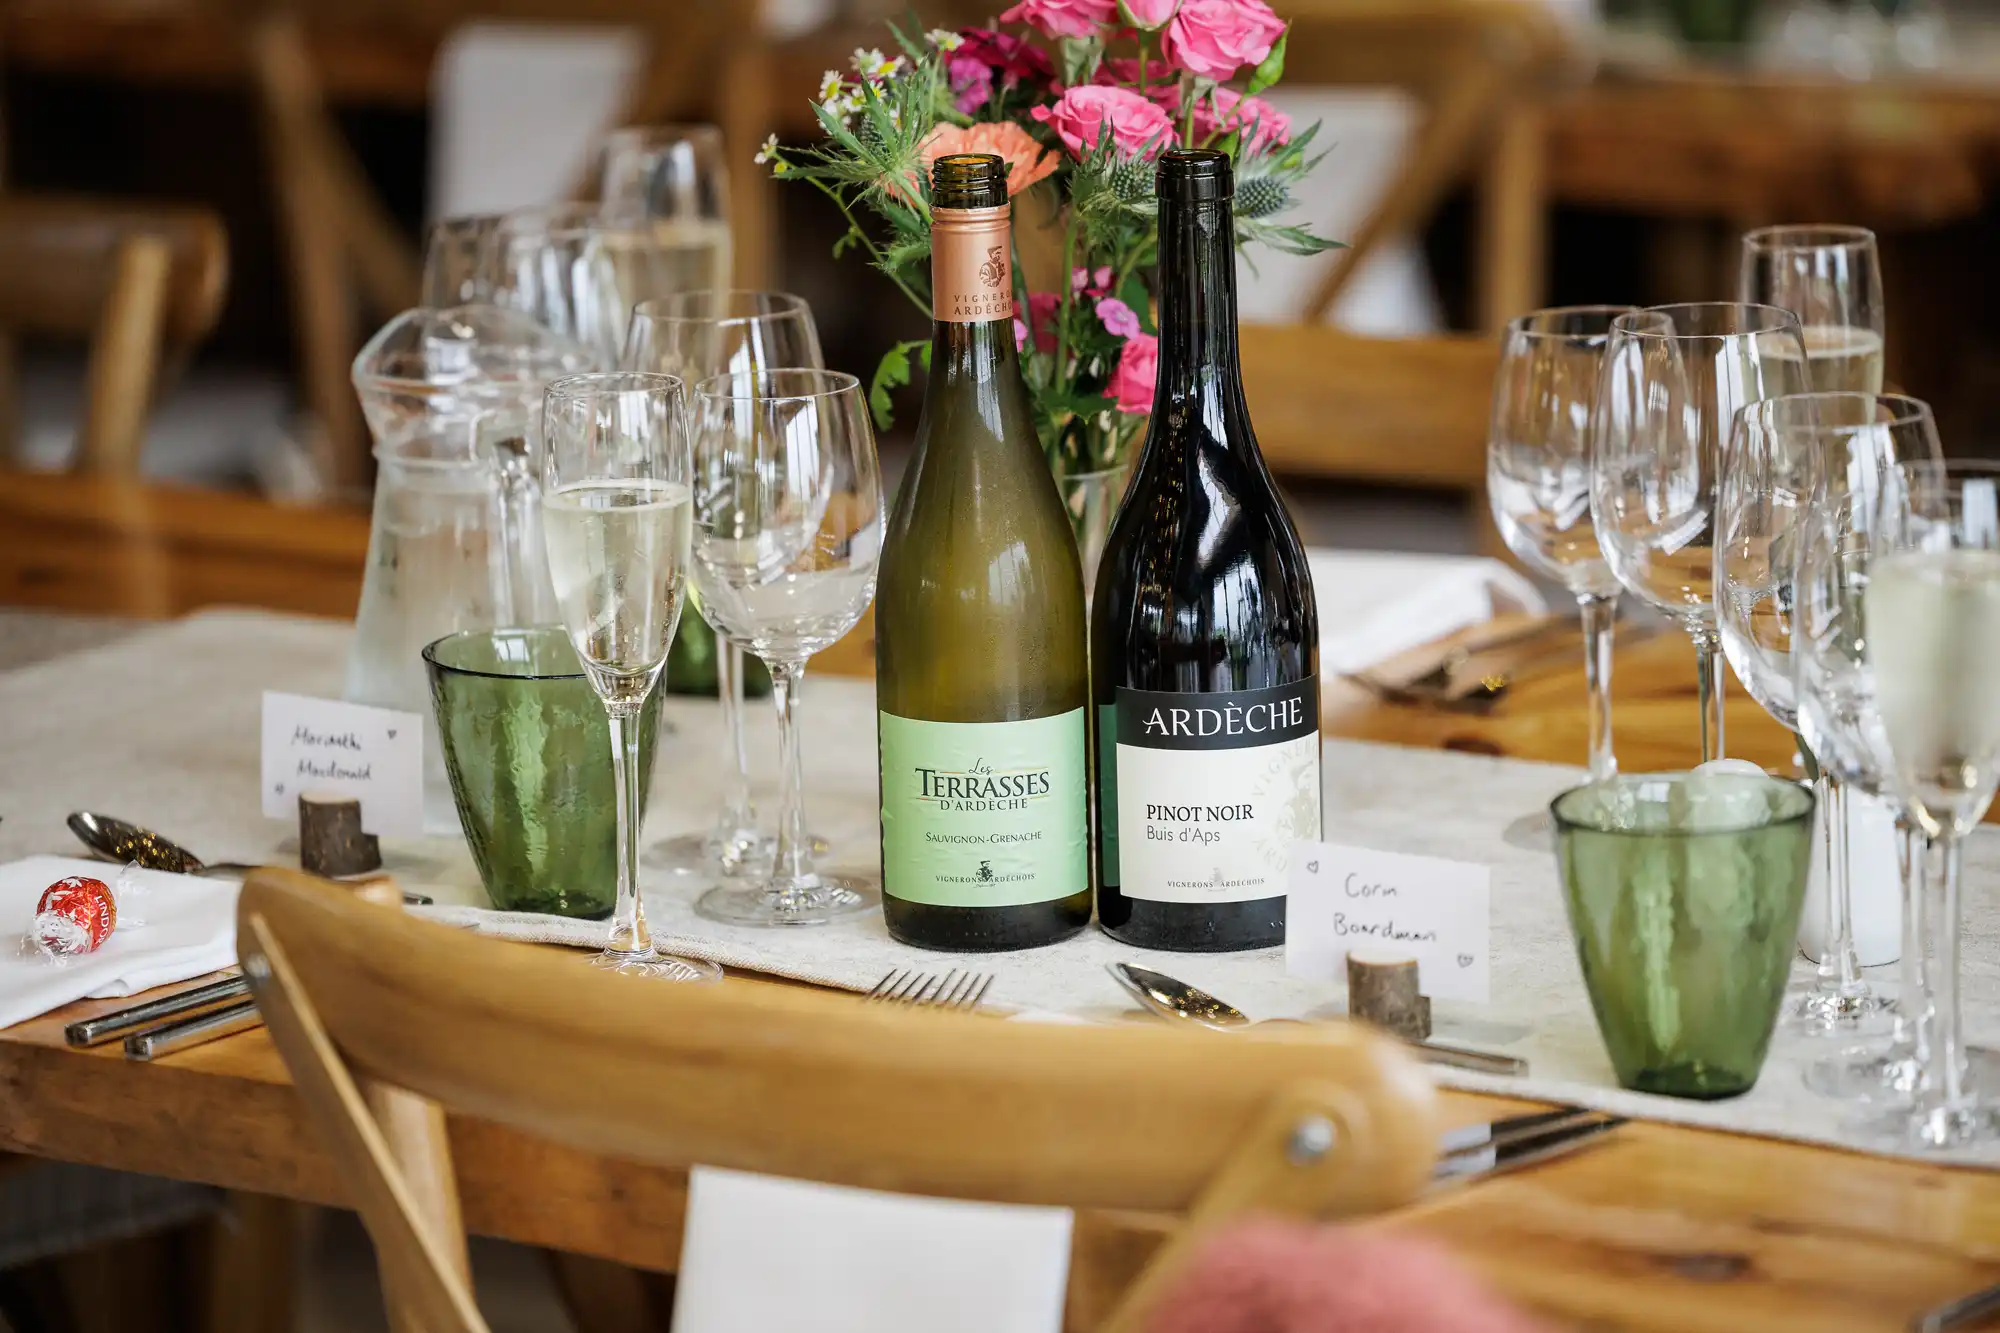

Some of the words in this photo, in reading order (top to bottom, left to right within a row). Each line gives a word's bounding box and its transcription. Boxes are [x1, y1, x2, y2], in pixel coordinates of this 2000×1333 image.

[953, 289, 1013, 303] VIGNERO
[1141, 696, 1304, 737] ARDÈCHE
[968, 757, 994, 775] Les
[914, 767, 1051, 799] TERRASSES
[940, 797, 1029, 812] D'ARDÈCHE
[1146, 804, 1202, 822] PINOT
[1206, 804, 1254, 822] NOIR
[1147, 825, 1174, 842] Buis
[1179, 827, 1221, 846] d'Aps
[935, 875, 983, 883] VIGNERONS
[1167, 880, 1214, 889] VIGNERONS
[94, 895, 110, 945] LINDOR
[1333, 912, 1437, 942] Boardman
